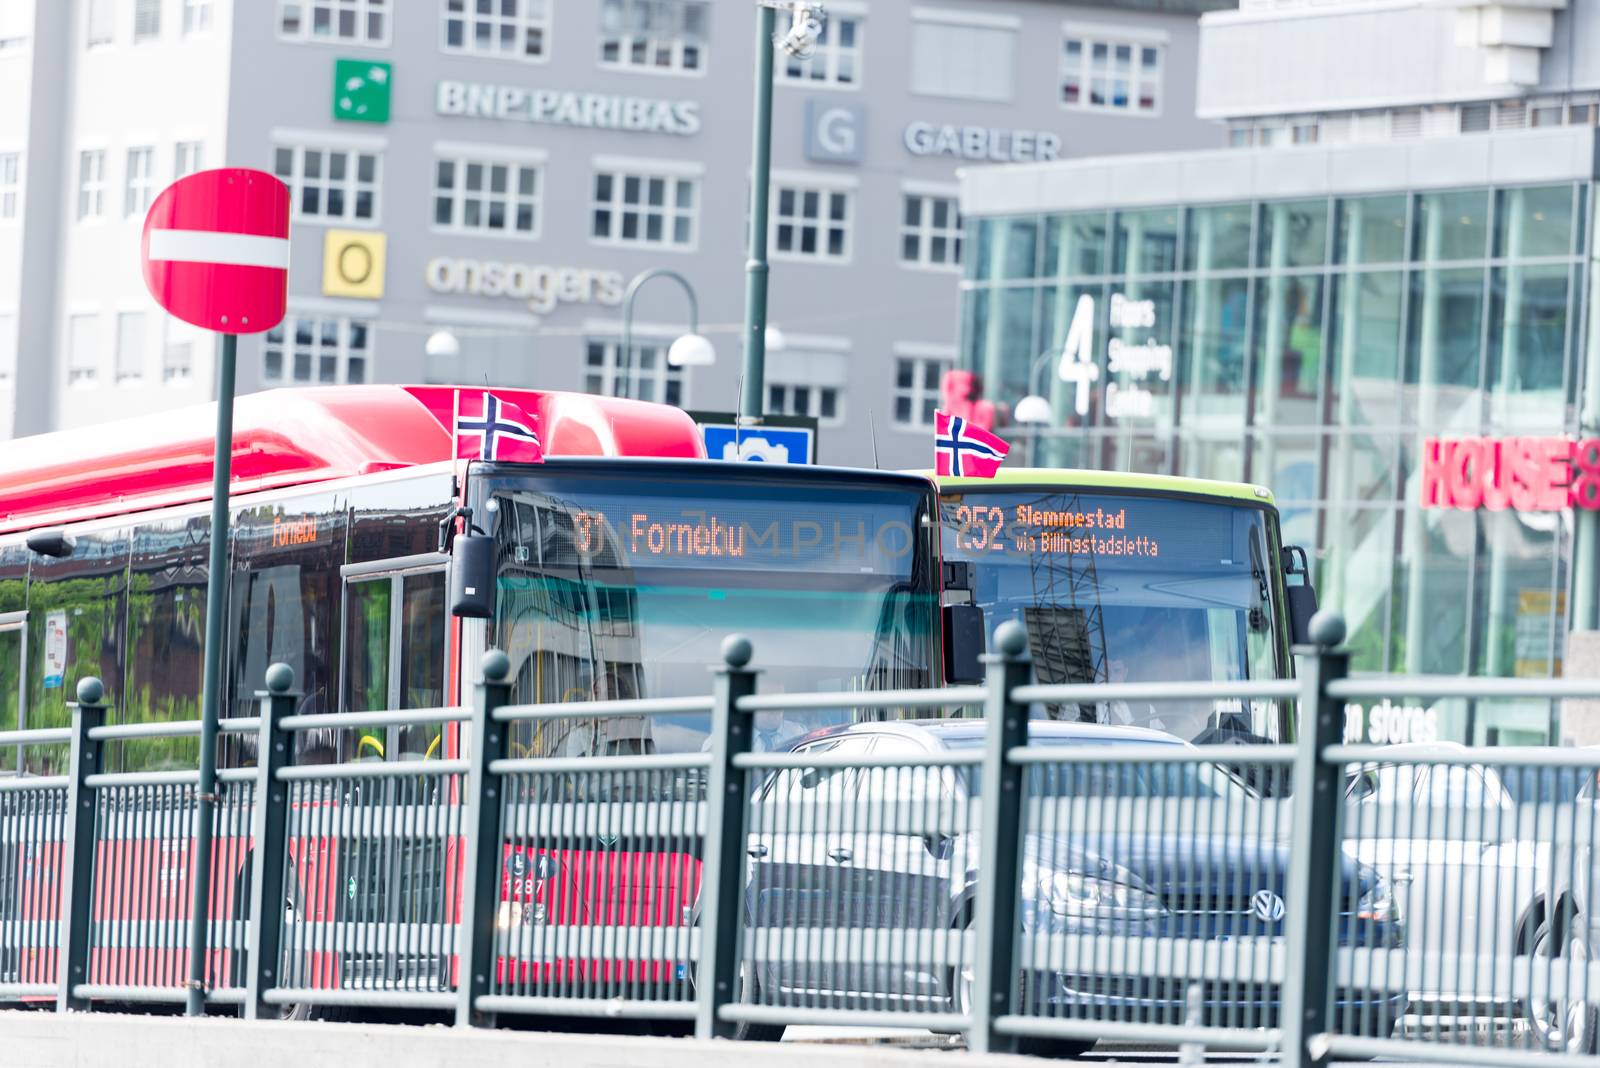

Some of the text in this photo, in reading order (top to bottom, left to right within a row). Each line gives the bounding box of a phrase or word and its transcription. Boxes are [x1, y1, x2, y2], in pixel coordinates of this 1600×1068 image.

[436, 81, 701, 136] BNP PARIBAS
[817, 108, 856, 154] G
[904, 121, 1062, 160] GABLER
[1058, 293, 1099, 417] 4
[1419, 435, 1574, 513] HOUSE
[271, 512, 317, 548] Fornebu
[631, 513, 745, 557] Fornebu
[956, 505, 1125, 551] 252 Slemmestad
[1368, 698, 1437, 745] stores
